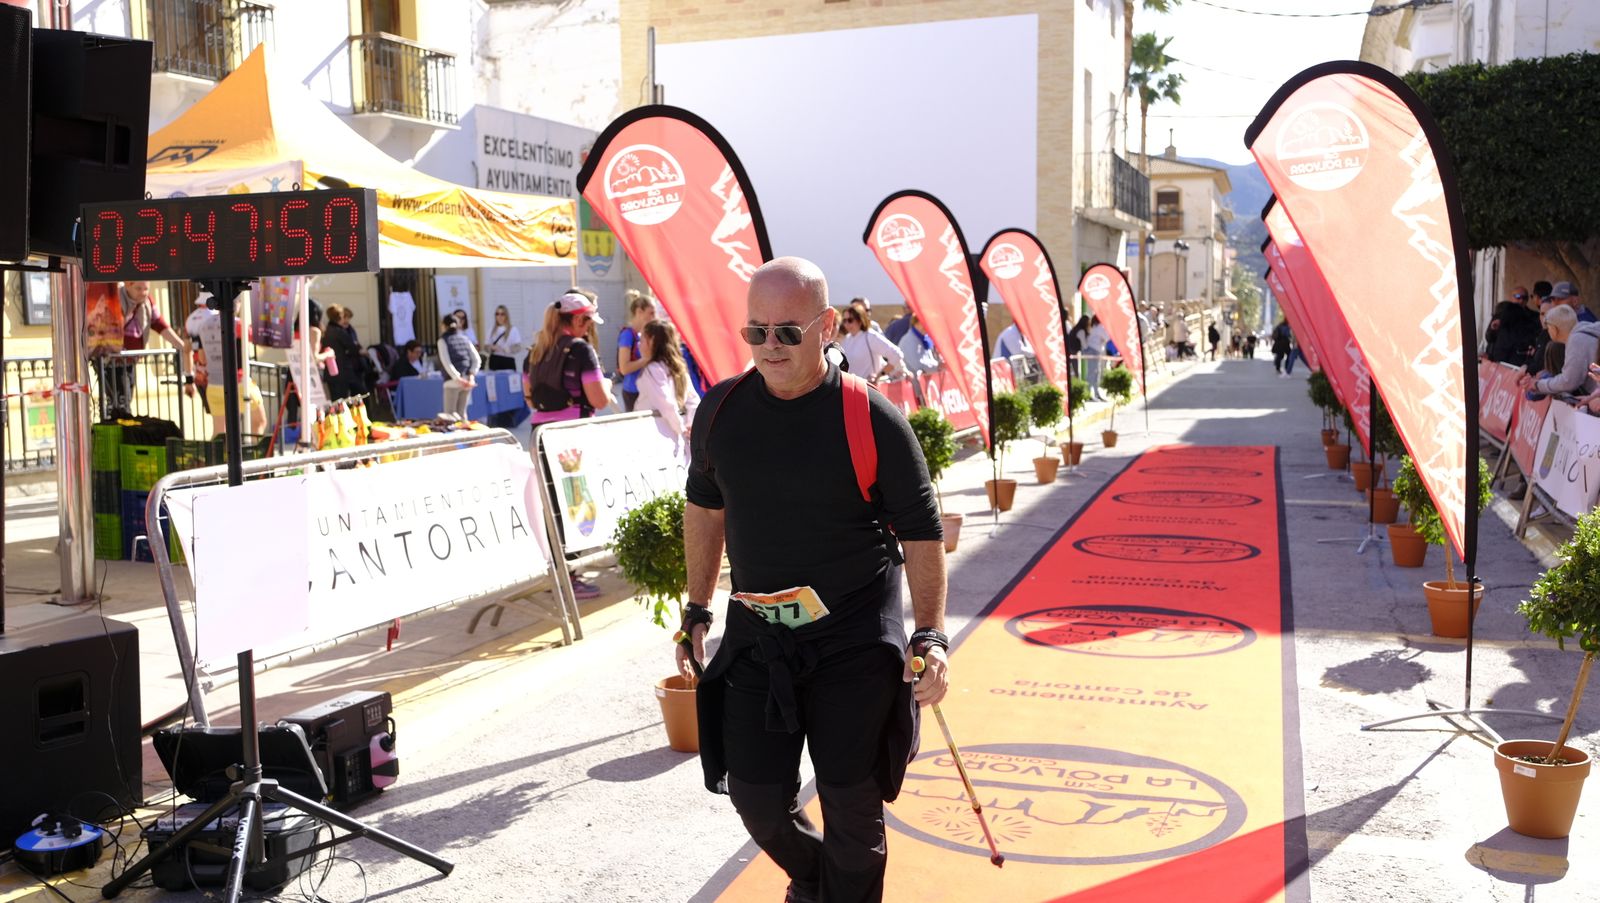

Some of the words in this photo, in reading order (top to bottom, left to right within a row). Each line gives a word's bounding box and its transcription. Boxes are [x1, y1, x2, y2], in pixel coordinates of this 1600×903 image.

[483, 135, 573, 169] EXCELENTÍSIMO
[487, 169, 572, 197] AYUNTAMIENTO
[93, 197, 359, 273] 02:47:50
[602, 464, 687, 509] CANTO
[317, 485, 482, 537] UNTAMIENTO
[308, 505, 529, 593] ANTORIA
[989, 688, 1209, 711] Ayuntamiento
[1014, 679, 1144, 696] Cantoria
[1152, 690, 1193, 699] de
[960, 752, 1057, 766] Cantoria
[1145, 776, 1198, 790] LA
[232, 816, 248, 860] VONYX
